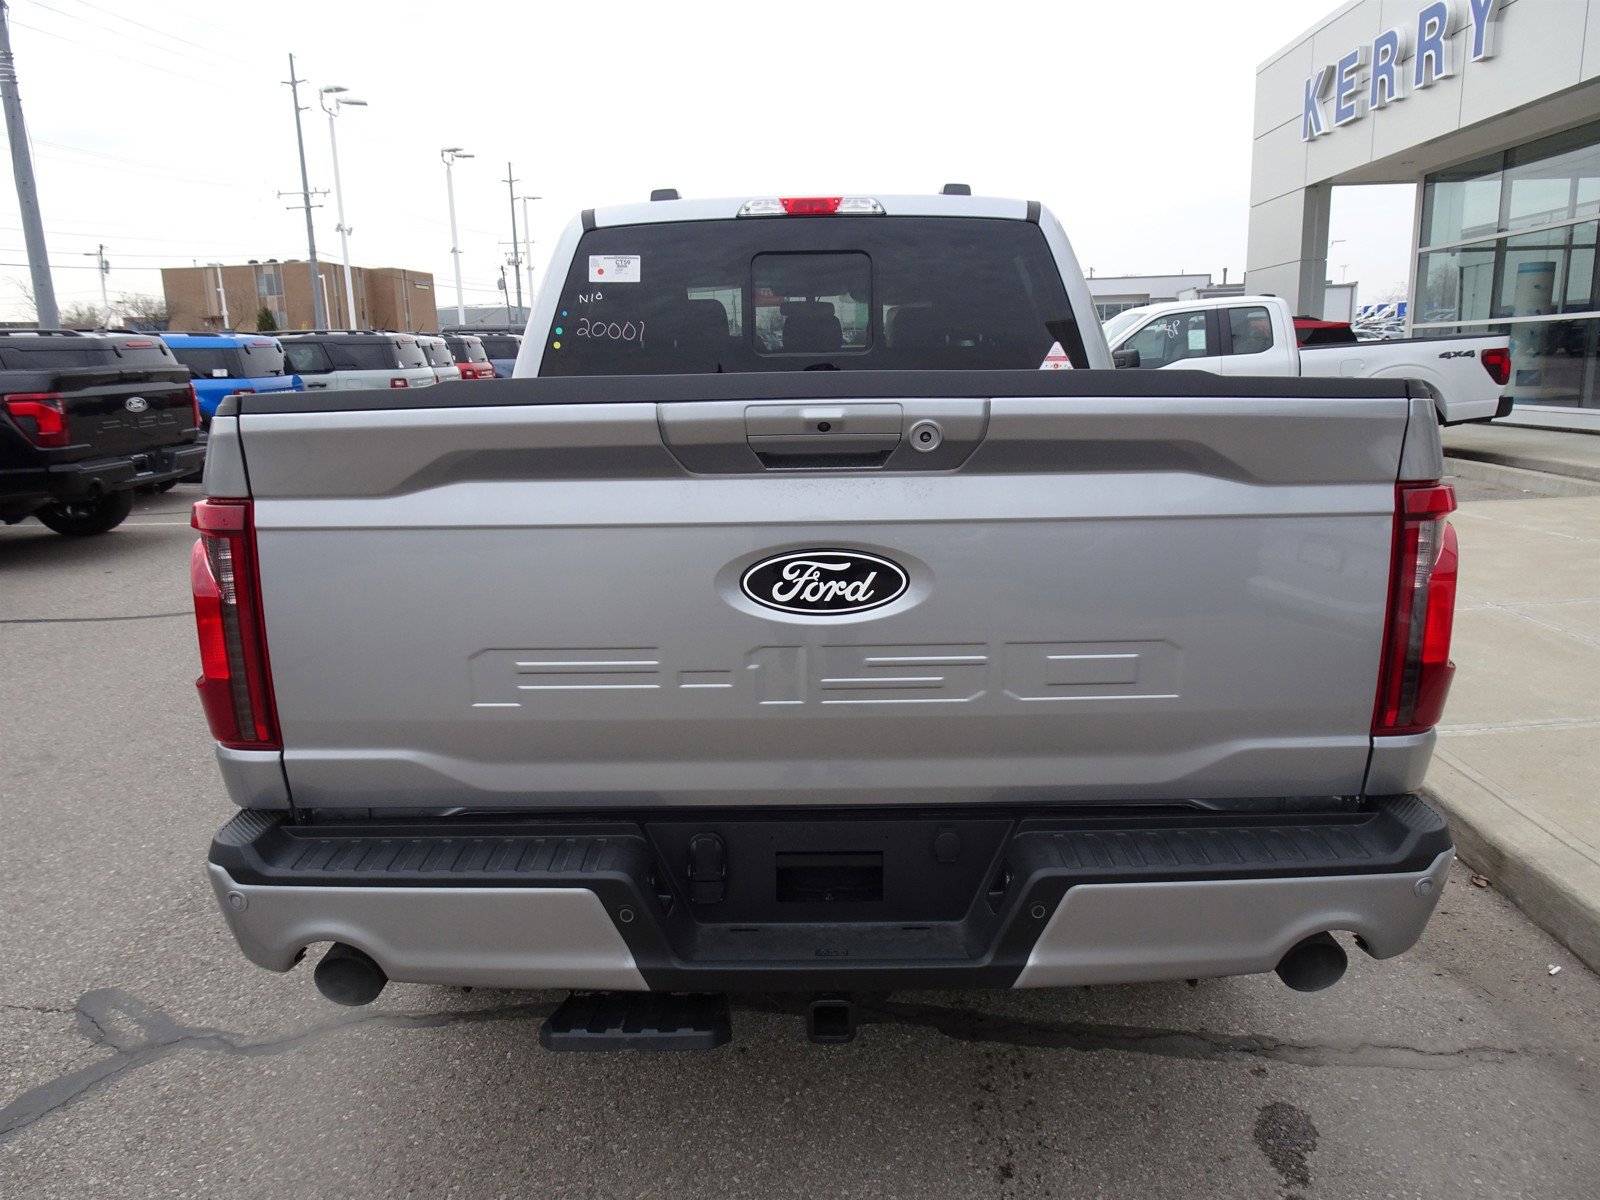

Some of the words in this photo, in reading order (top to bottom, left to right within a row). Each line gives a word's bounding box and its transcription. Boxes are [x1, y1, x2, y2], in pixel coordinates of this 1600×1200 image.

[1302, 0, 1499, 142] KERRY
[771, 560, 878, 602] Ford
[467, 639, 1184, 707] F-150
